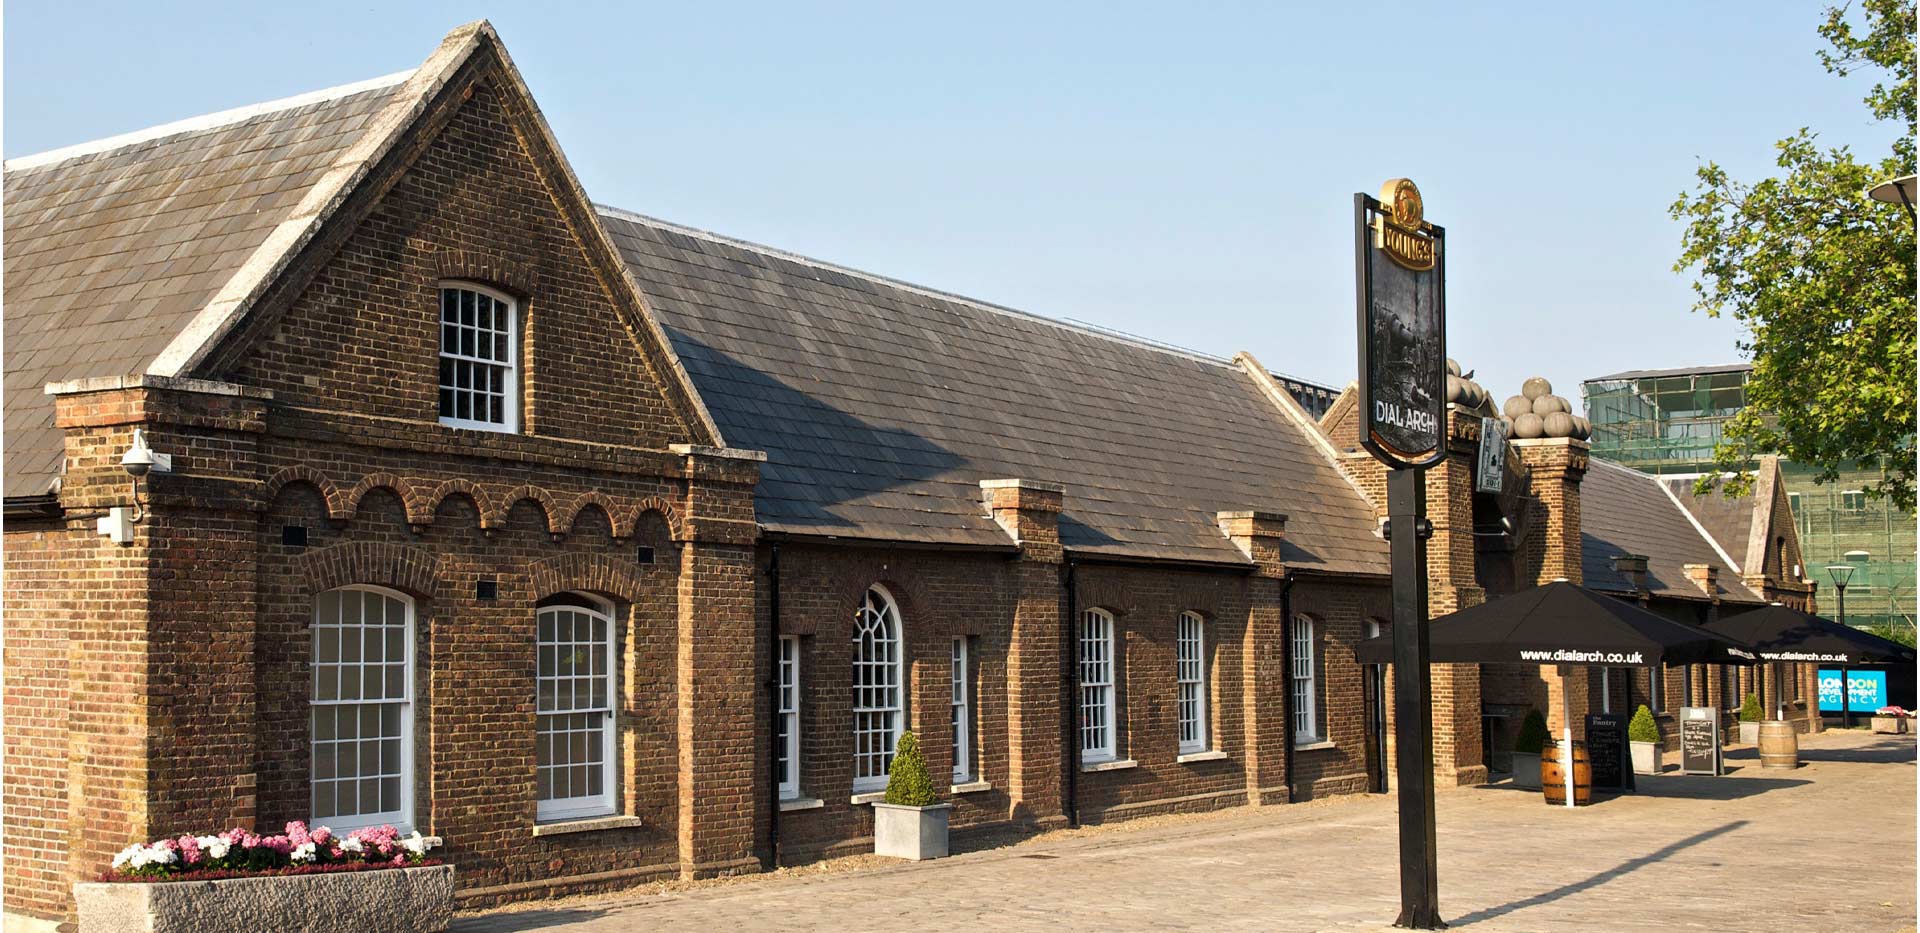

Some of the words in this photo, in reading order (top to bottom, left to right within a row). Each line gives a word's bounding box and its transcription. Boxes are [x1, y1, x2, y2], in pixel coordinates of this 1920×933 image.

[1385, 226, 1430, 261] YOUNG'S
[1376, 400, 1404, 427] DIAL
[1405, 408, 1435, 434] ARCH
[1520, 649, 1643, 664] www.dialarch.co.uk
[1818, 678, 1877, 689] LONDON
[1818, 688, 1877, 696] DEVELPMENT
